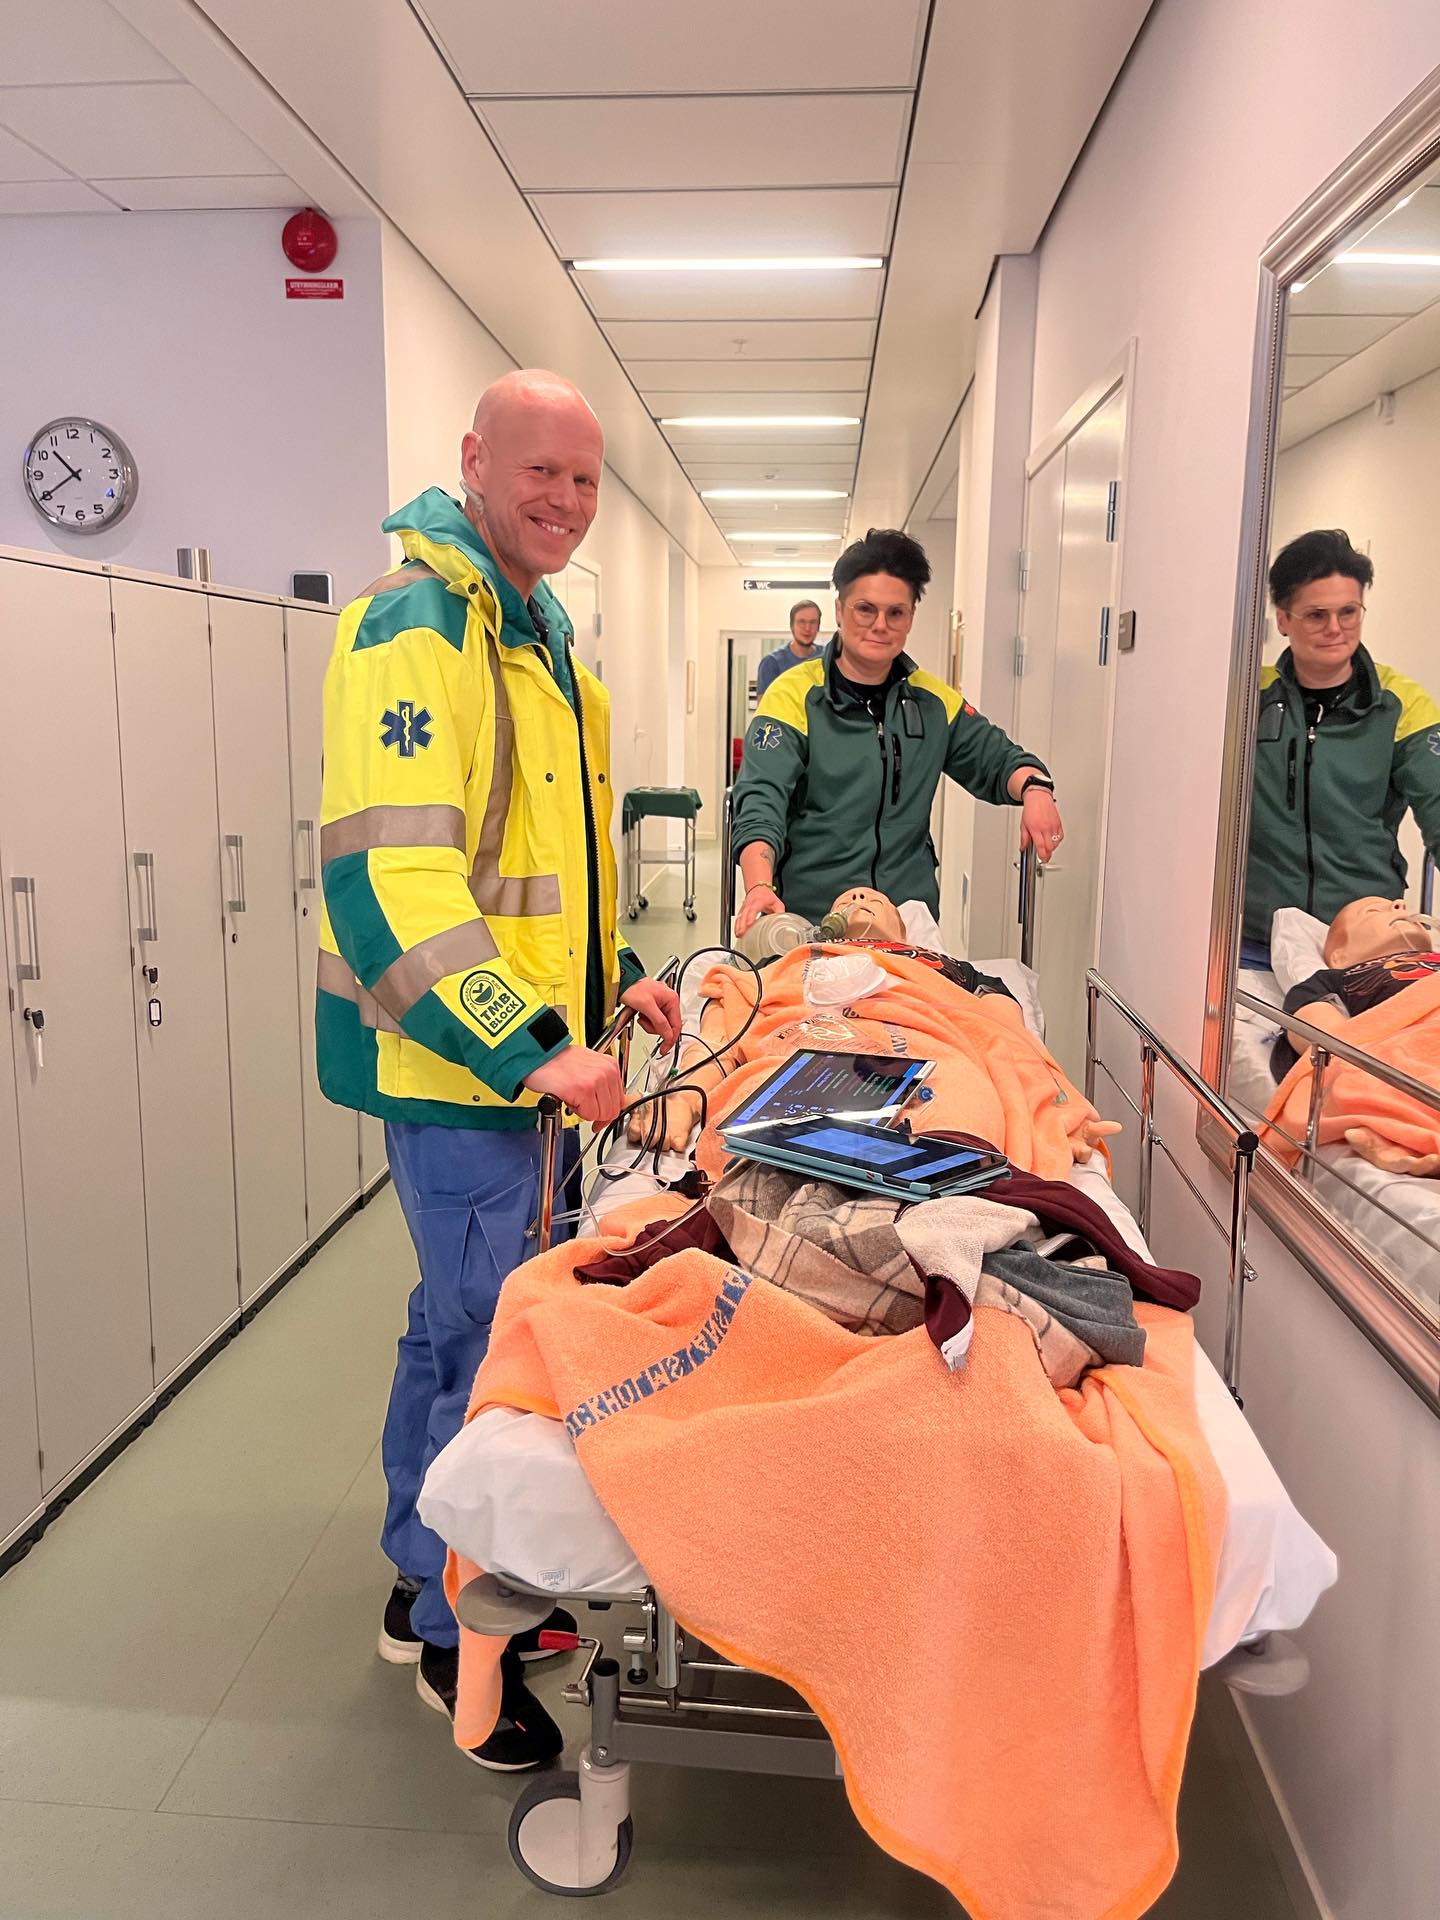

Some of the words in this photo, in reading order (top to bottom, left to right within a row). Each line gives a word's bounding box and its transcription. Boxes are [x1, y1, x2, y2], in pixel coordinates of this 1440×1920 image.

[66, 429, 80, 439] 12
[90, 433, 94, 443] 1
[50, 436, 58, 446] 11
[38, 450, 49, 461] 10
[102, 448, 111, 458] 2
[33, 470, 44, 480] 9
[109, 469, 119, 479] 3
[42, 490, 52, 501] 8
[105, 487, 115, 498] 4
[57, 505, 66, 515] 7
[94, 504, 104, 514] 5
[75, 510, 85, 520] 6
[480, 993, 511, 1021] TMB
[489, 1000, 519, 1029] BLOCK
